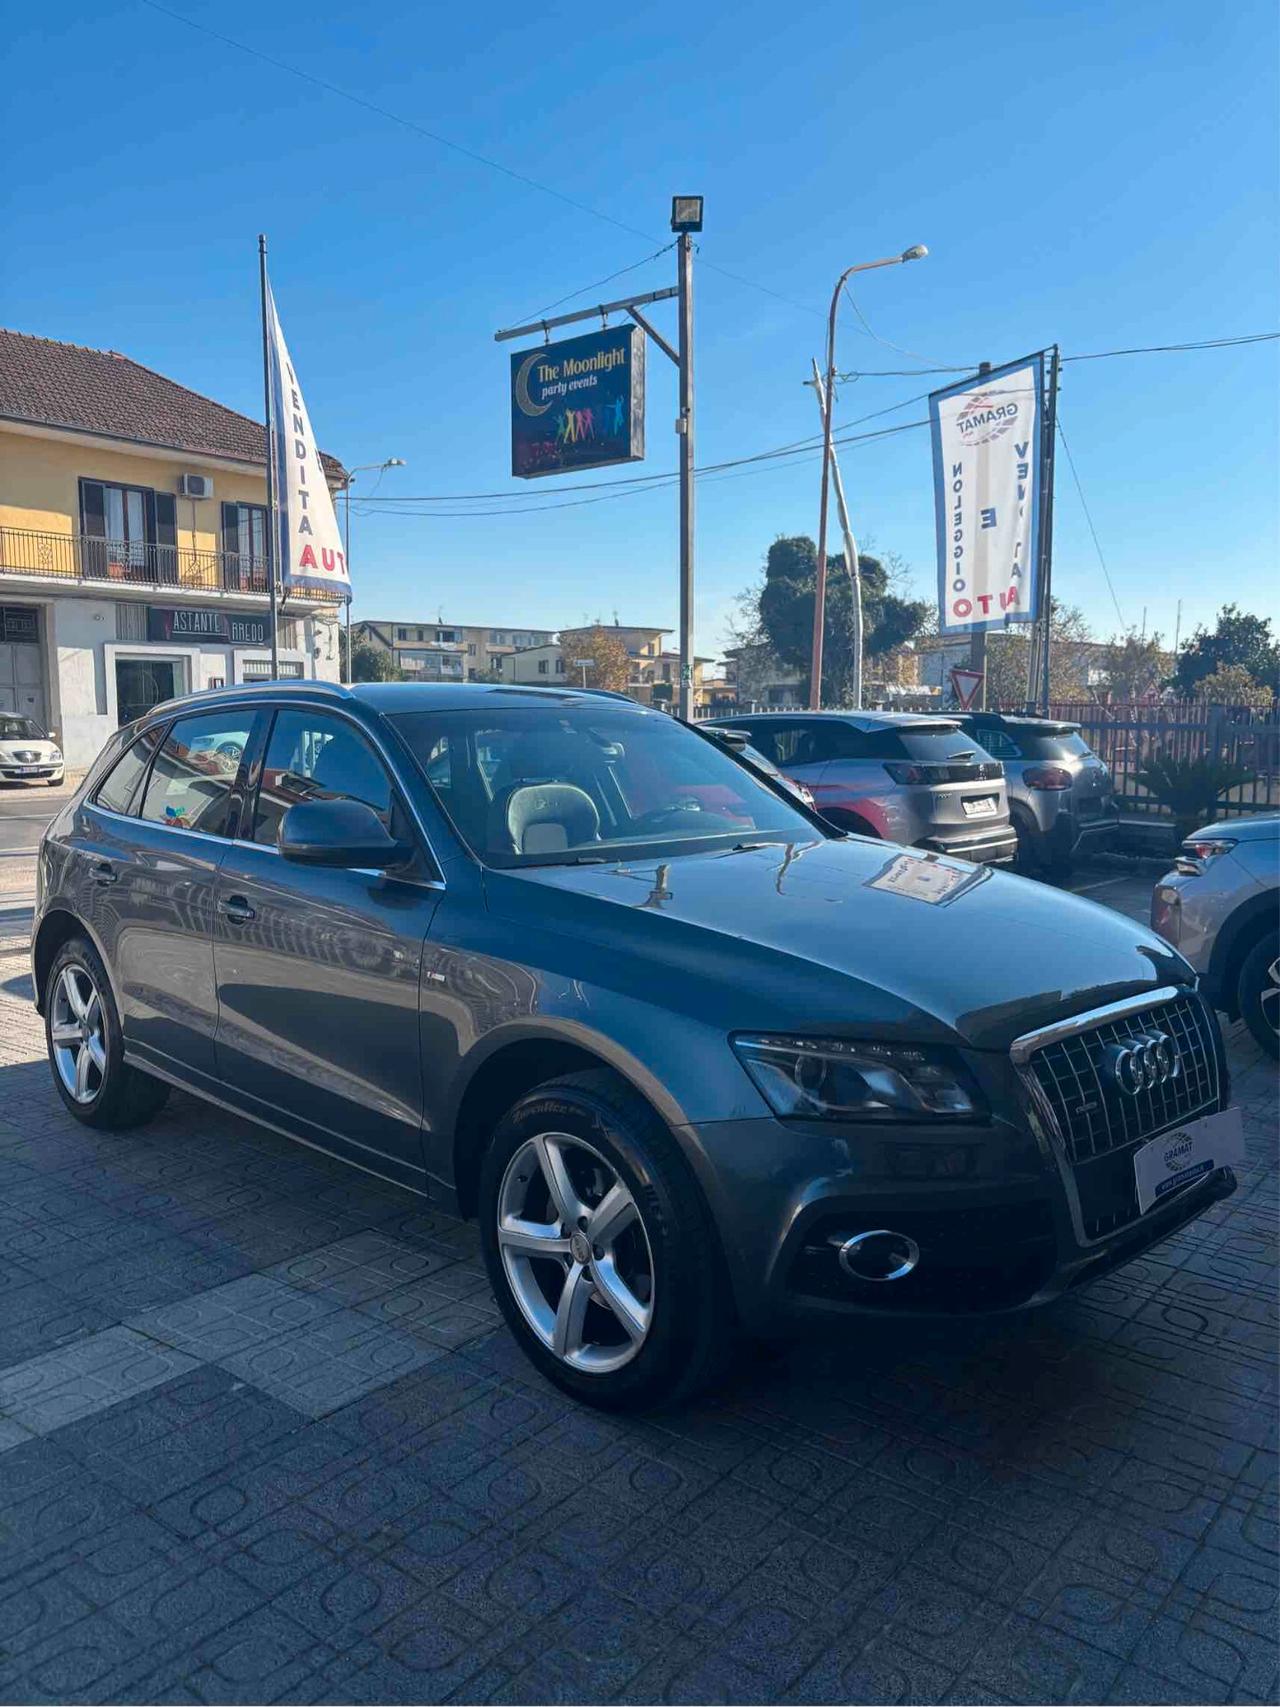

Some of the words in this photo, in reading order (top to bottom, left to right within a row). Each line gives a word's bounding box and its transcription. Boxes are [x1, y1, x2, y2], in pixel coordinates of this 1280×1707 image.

[538, 365, 559, 382] The
[563, 347, 625, 376] Moonlight
[541, 383, 567, 399] party
[568, 375, 598, 391] events
[1164, 1142, 1193, 1161] GRAMAT
